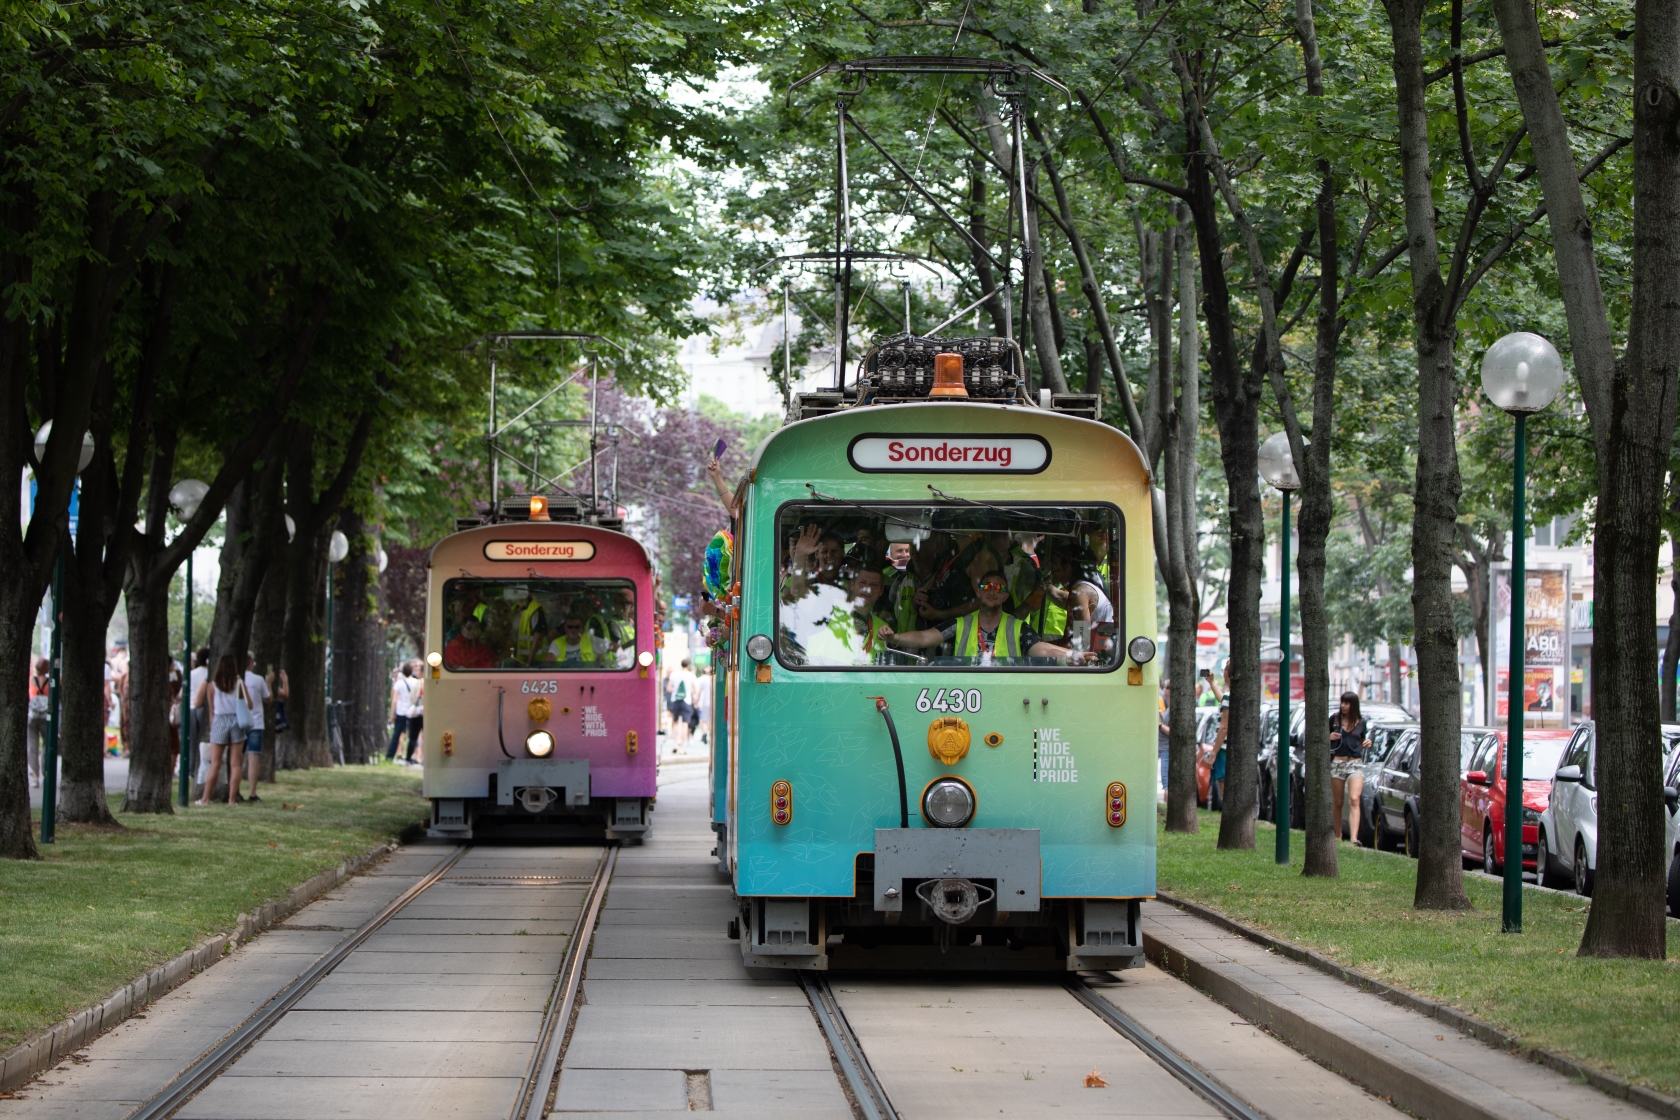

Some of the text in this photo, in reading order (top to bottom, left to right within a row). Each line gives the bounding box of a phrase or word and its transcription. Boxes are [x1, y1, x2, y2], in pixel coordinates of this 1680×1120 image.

[888, 441, 1012, 467] Sonderzug
[505, 543, 575, 558] Sonderzug
[521, 680, 558, 694] 6425
[915, 687, 982, 713] 6430
[585, 705, 597, 714] WE
[585, 713, 603, 721] RIDE
[585, 721, 606, 729] WITH
[585, 729, 608, 737] PRIDE
[1039, 728, 1061, 742] WE
[1039, 742, 1070, 755] RIDE
[1039, 756, 1075, 769] WITH
[1039, 769, 1079, 783] PRIDE
